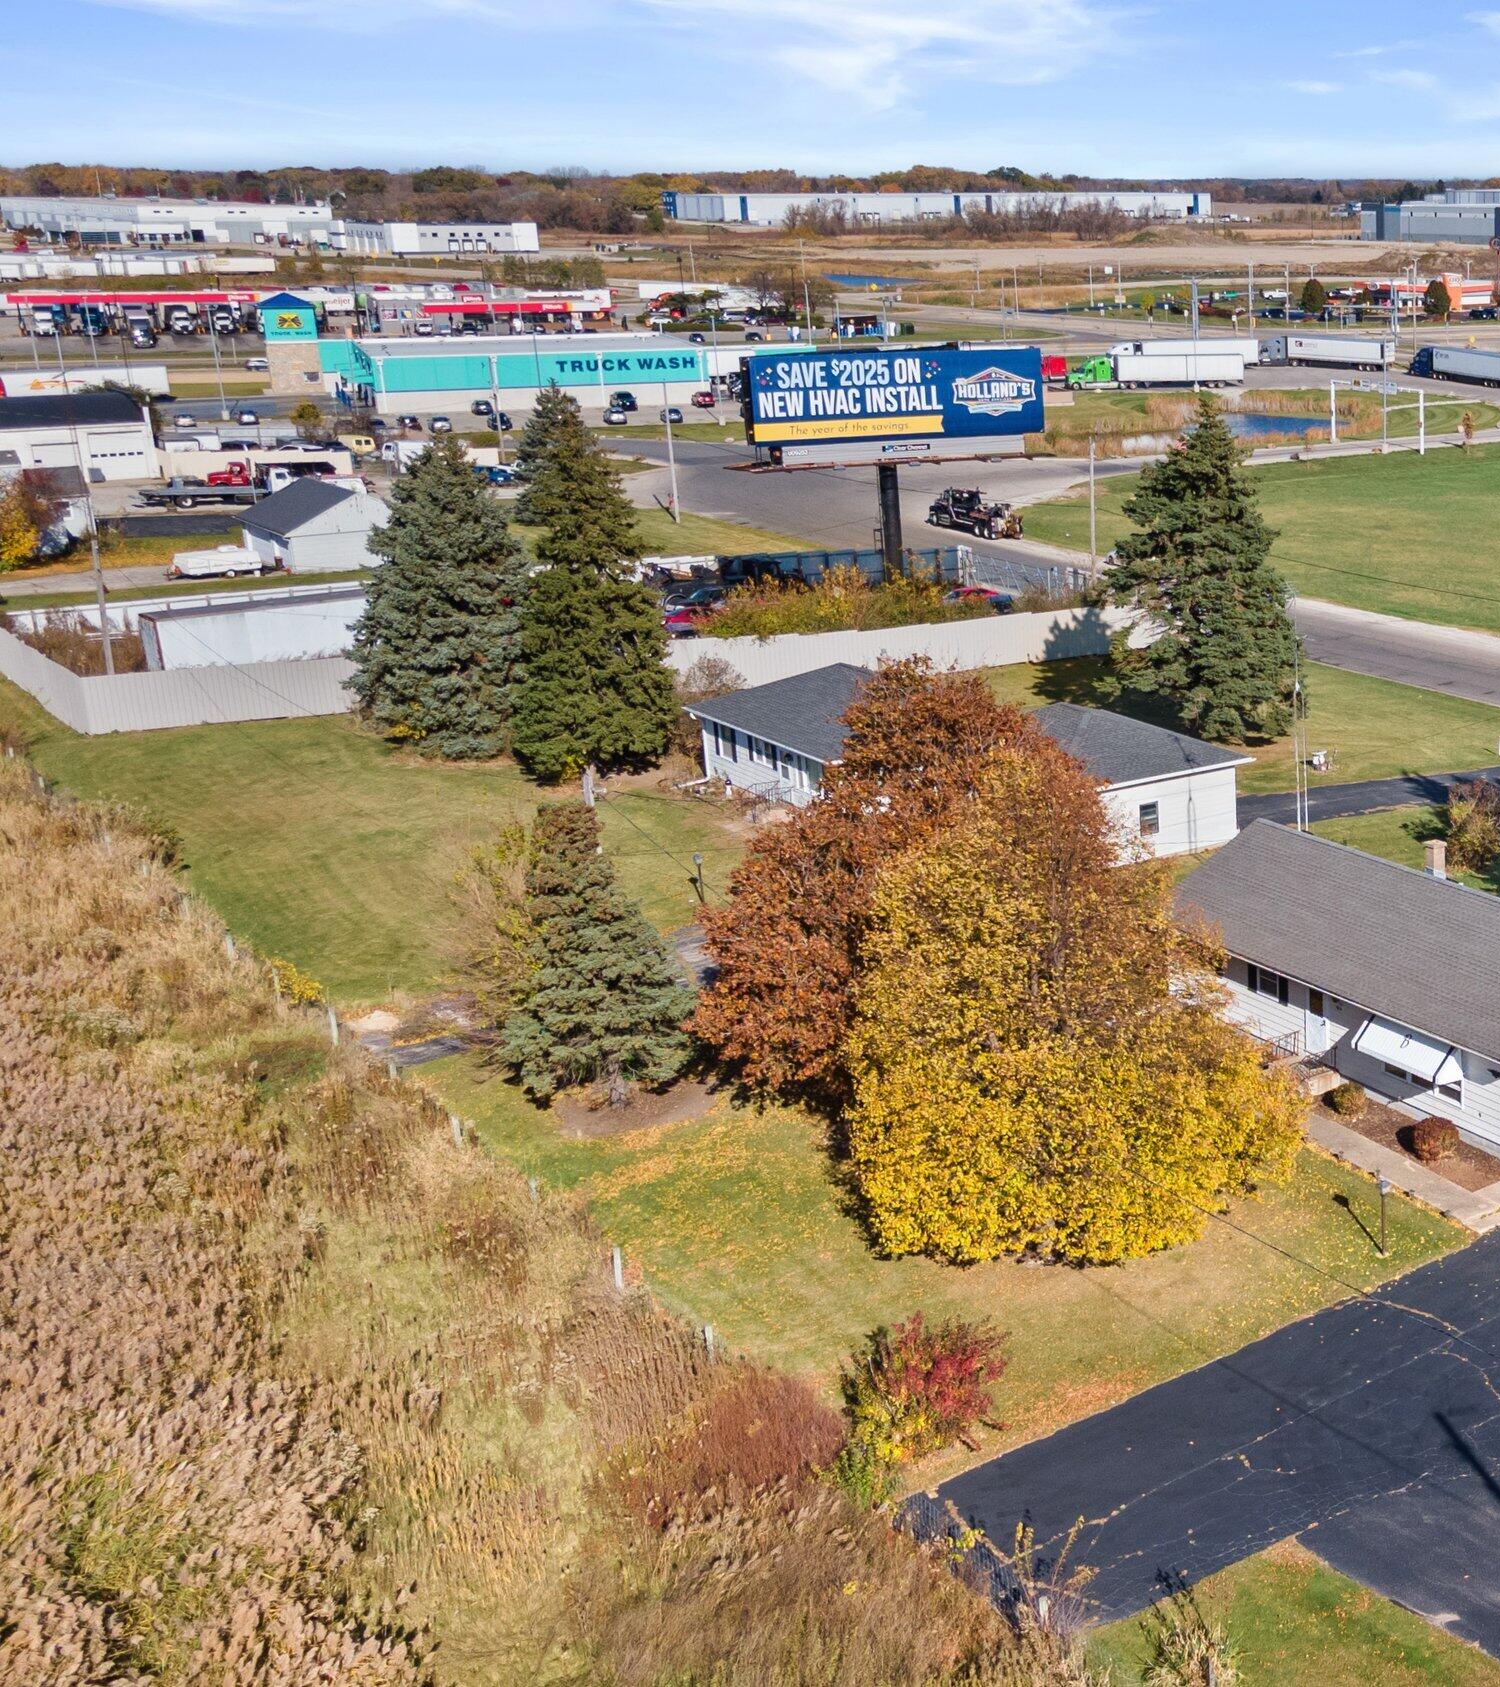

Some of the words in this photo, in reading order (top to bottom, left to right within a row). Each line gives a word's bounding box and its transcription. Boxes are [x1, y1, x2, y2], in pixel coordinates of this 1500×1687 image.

[556, 359, 631, 373] TRUCK
[637, 357, 696, 370] WASH
[776, 361, 828, 389] SAVE
[831, 358, 890, 387] $2025
[893, 358, 921, 384] ON
[957, 381, 1031, 399] HOLLAND'S
[758, 391, 804, 418] NEW
[809, 388, 861, 416] HVAC
[865, 385, 944, 413] INSTALL
[789, 425, 808, 435] The
[812, 426, 835, 436] year
[838, 422, 849, 433] of
[852, 421, 868, 432] the
